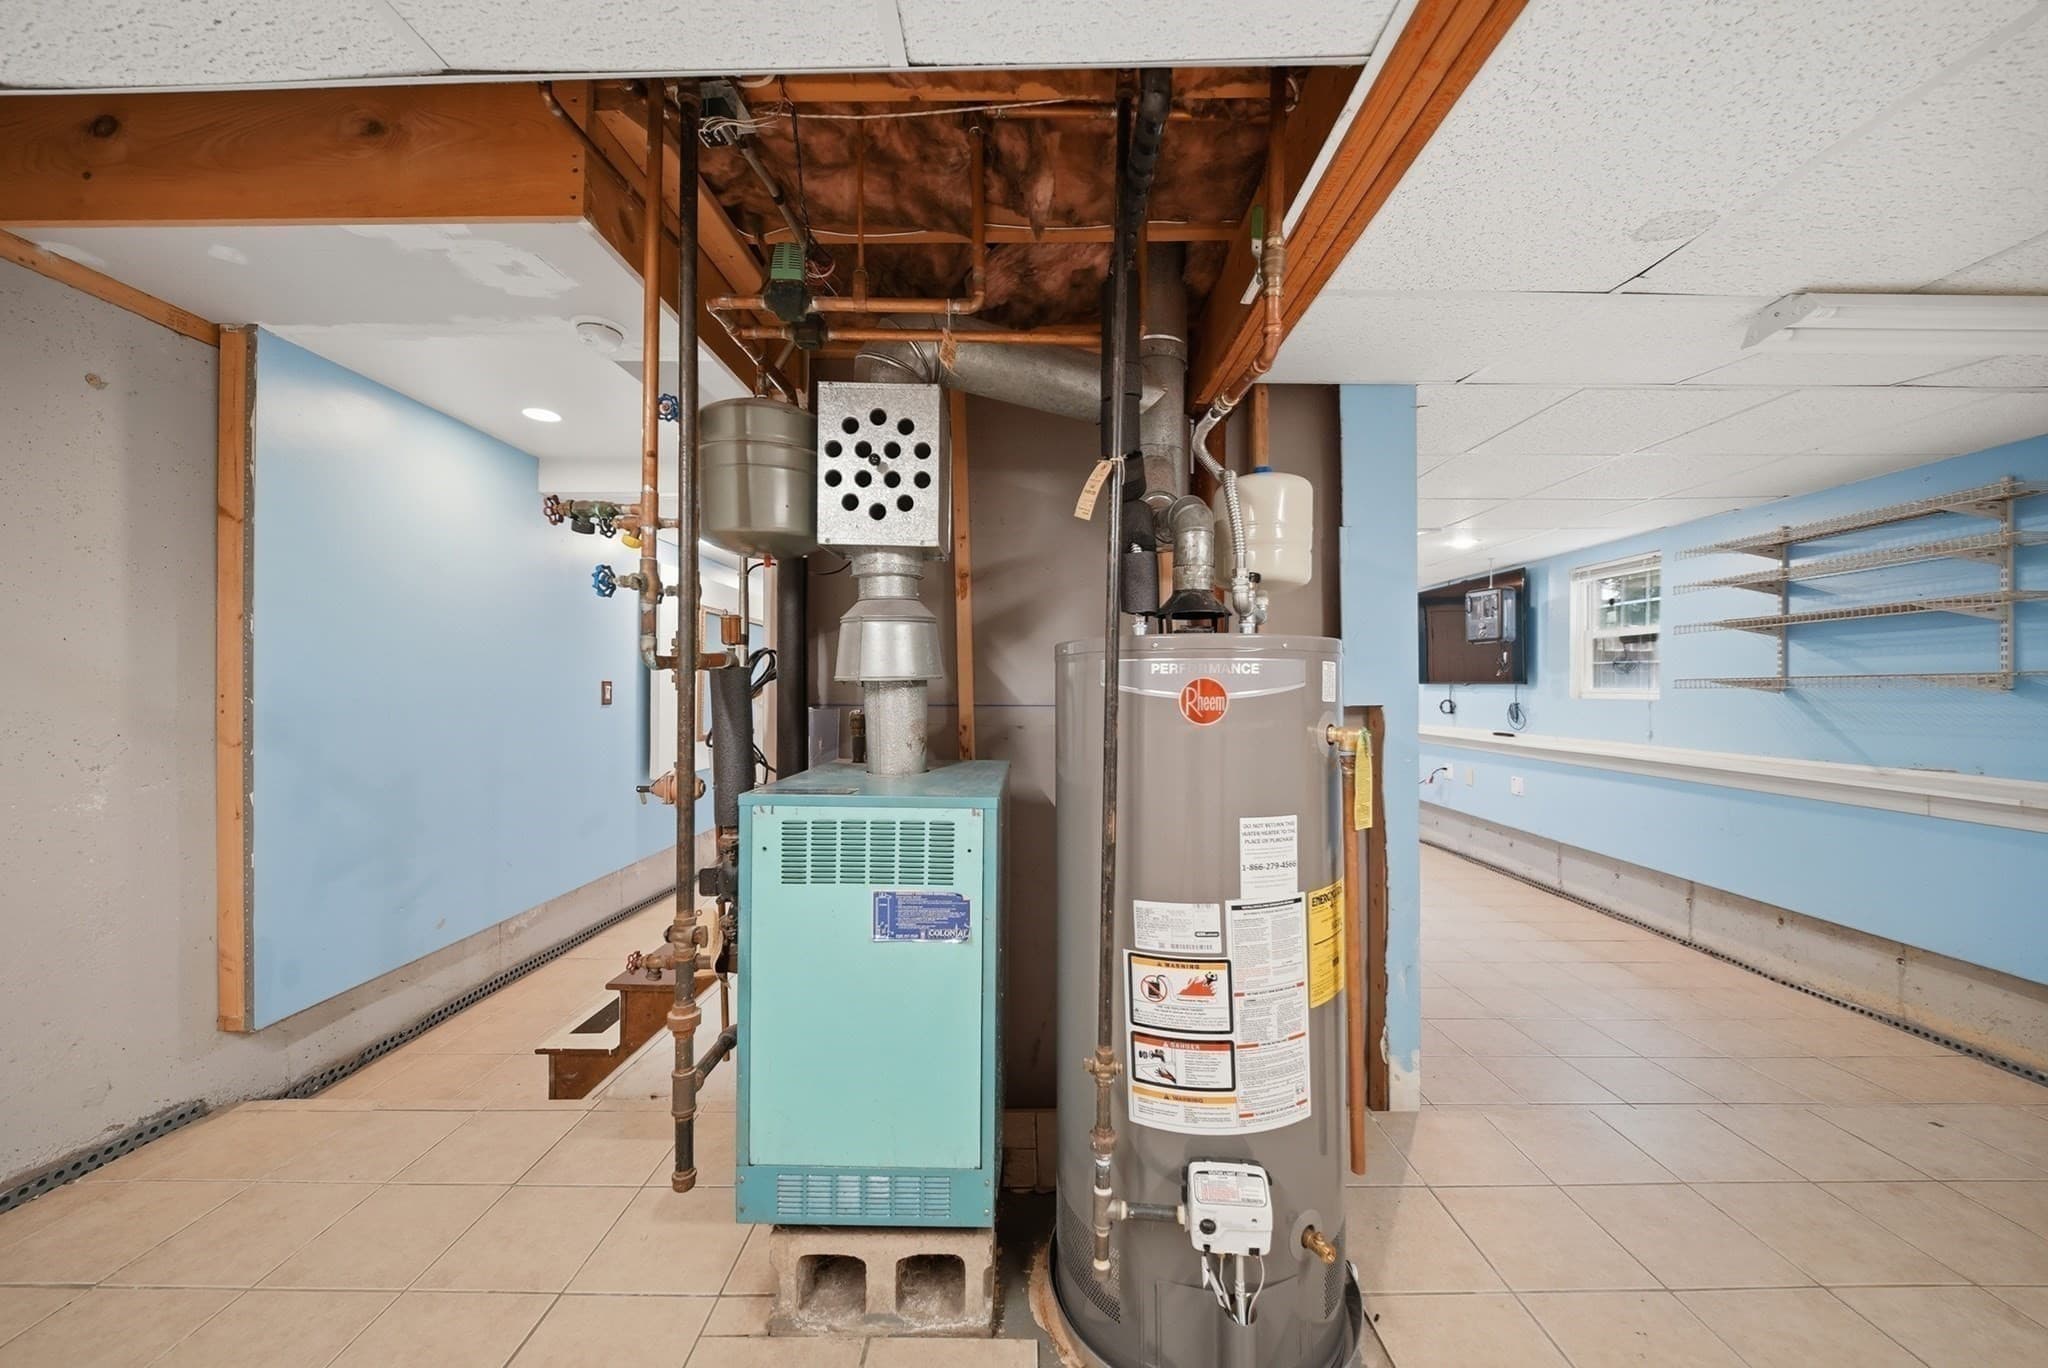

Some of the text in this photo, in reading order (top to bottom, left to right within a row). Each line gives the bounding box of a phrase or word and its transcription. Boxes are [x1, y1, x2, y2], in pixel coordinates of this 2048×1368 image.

[1151, 663, 1260, 674] PERFRMANCE
[1186, 680, 1225, 718] Rheem
[1164, 962, 1200, 970] WARNING
